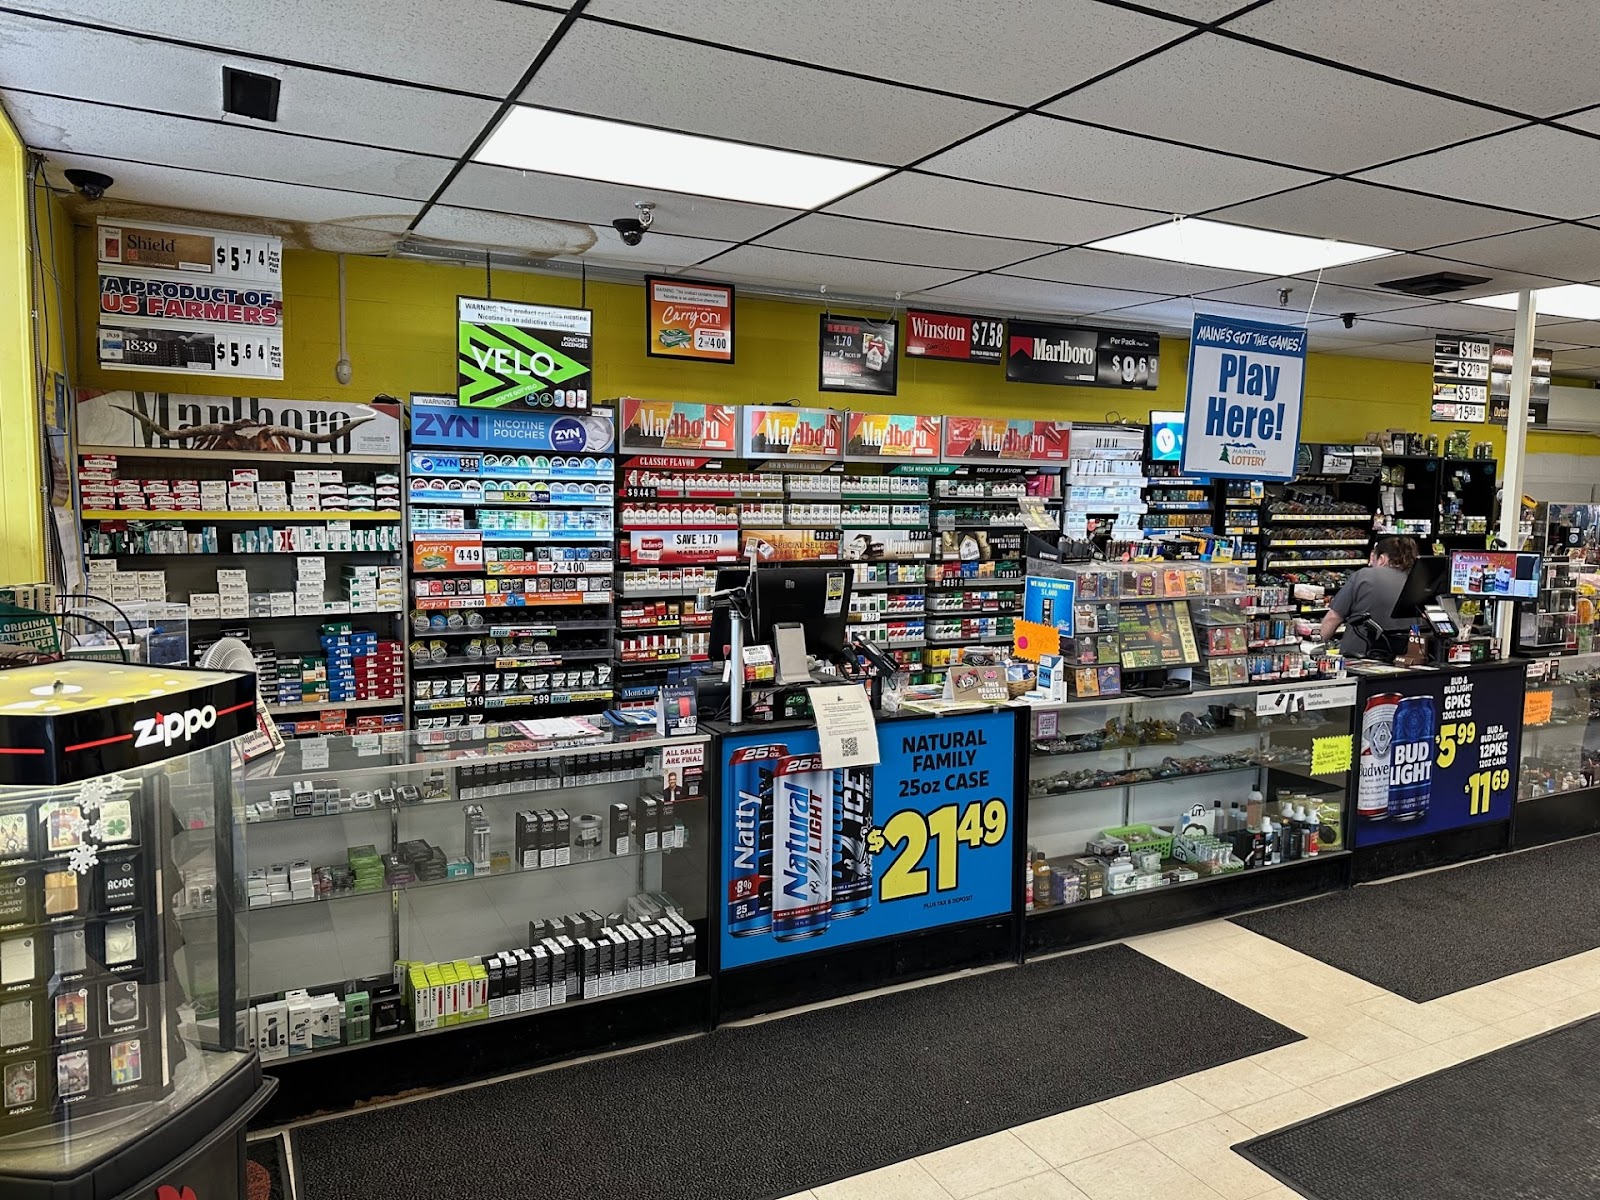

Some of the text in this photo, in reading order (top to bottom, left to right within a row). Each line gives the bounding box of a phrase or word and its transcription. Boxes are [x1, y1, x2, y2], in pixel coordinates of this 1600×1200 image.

[127, 234, 176, 253] Shield
[105, 278, 273, 306] A PRODUCT OF
[101, 294, 278, 326] US FARMERS
[465, 303, 498, 312] WARNING:
[514, 309, 537, 317] product
[662, 306, 699, 328] Carry
[478, 313, 504, 321] Nicotine
[521, 318, 548, 326] addictive
[911, 316, 965, 342] Winston
[971, 320, 1003, 348] $7.58
[561, 341, 588, 349] LOZENGES
[563, 336, 588, 344] POUCHES
[698, 337, 703, 347] 2
[1110, 337, 1136, 346] Per Pack
[1197, 325, 1306, 352] MAINE'S GOT THE GAMES!
[124, 339, 158, 353] 1839
[1033, 338, 1094, 364] Marlboro
[470, 345, 555, 377] VELO
[839, 350, 844, 360] 2
[1219, 353, 1280, 401] Play
[415, 412, 480, 438] ZYN
[493, 419, 545, 431] NICOTINE
[640, 408, 719, 440] Marlboro
[1205, 396, 1286, 441] Here!
[493, 428, 545, 440] POUCHES
[555, 428, 580, 440] ZYN
[765, 418, 835, 448] Marlboro
[862, 421, 927, 448] Marlboro
[981, 425, 1045, 453] Marlboro
[436, 459, 457, 467] ZYN
[639, 457, 695, 468] CLASSIC FLAVOR
[1231, 455, 1266, 466] LOTTERY
[901, 465, 950, 474] FRESH MENTHOL FLAVOR
[676, 534, 697, 545] SAVE
[773, 541, 804, 549] SPECIAL
[416, 544, 438, 555] Carry
[553, 562, 558, 573] 2
[785, 580, 795, 589] Elo
[4, 618, 51, 633] ORIGINAL
[22, 629, 51, 640] PURE.
[1451, 675, 1468, 685] BUD &
[624, 689, 656, 697] Montclair
[1444, 683, 1474, 694] BUD LIGHT
[1444, 693, 1472, 710] 6PKS
[1456, 708, 1472, 719] CANS
[133, 704, 217, 748] zippo
[1487, 724, 1503, 735] BUD &
[902, 729, 987, 753] NATURAL
[1480, 731, 1508, 743] BUD LIGHT
[665, 747, 702, 757] ALL SALES
[742, 747, 769, 761] 25
[1395, 741, 1429, 765] BUD
[1479, 741, 1508, 758] 12PKS
[665, 756, 702, 765] ARE FINAL
[785, 759, 812, 772] 25
[912, 749, 977, 773] FAMILY
[1492, 755, 1507, 766] CANS
[1390, 760, 1432, 786] LIGHT
[898, 770, 990, 798] 25oz CASE
[843, 768, 864, 824] ICE
[734, 790, 764, 869] Natty
[808, 790, 823, 855] LIGHT
[783, 782, 809, 901] Natural
[107, 877, 134, 890] AC/DC
[923, 901, 938, 909] PLUS
[951, 894, 973, 904] DEPOSIT
[736, 904, 748, 914] 25
